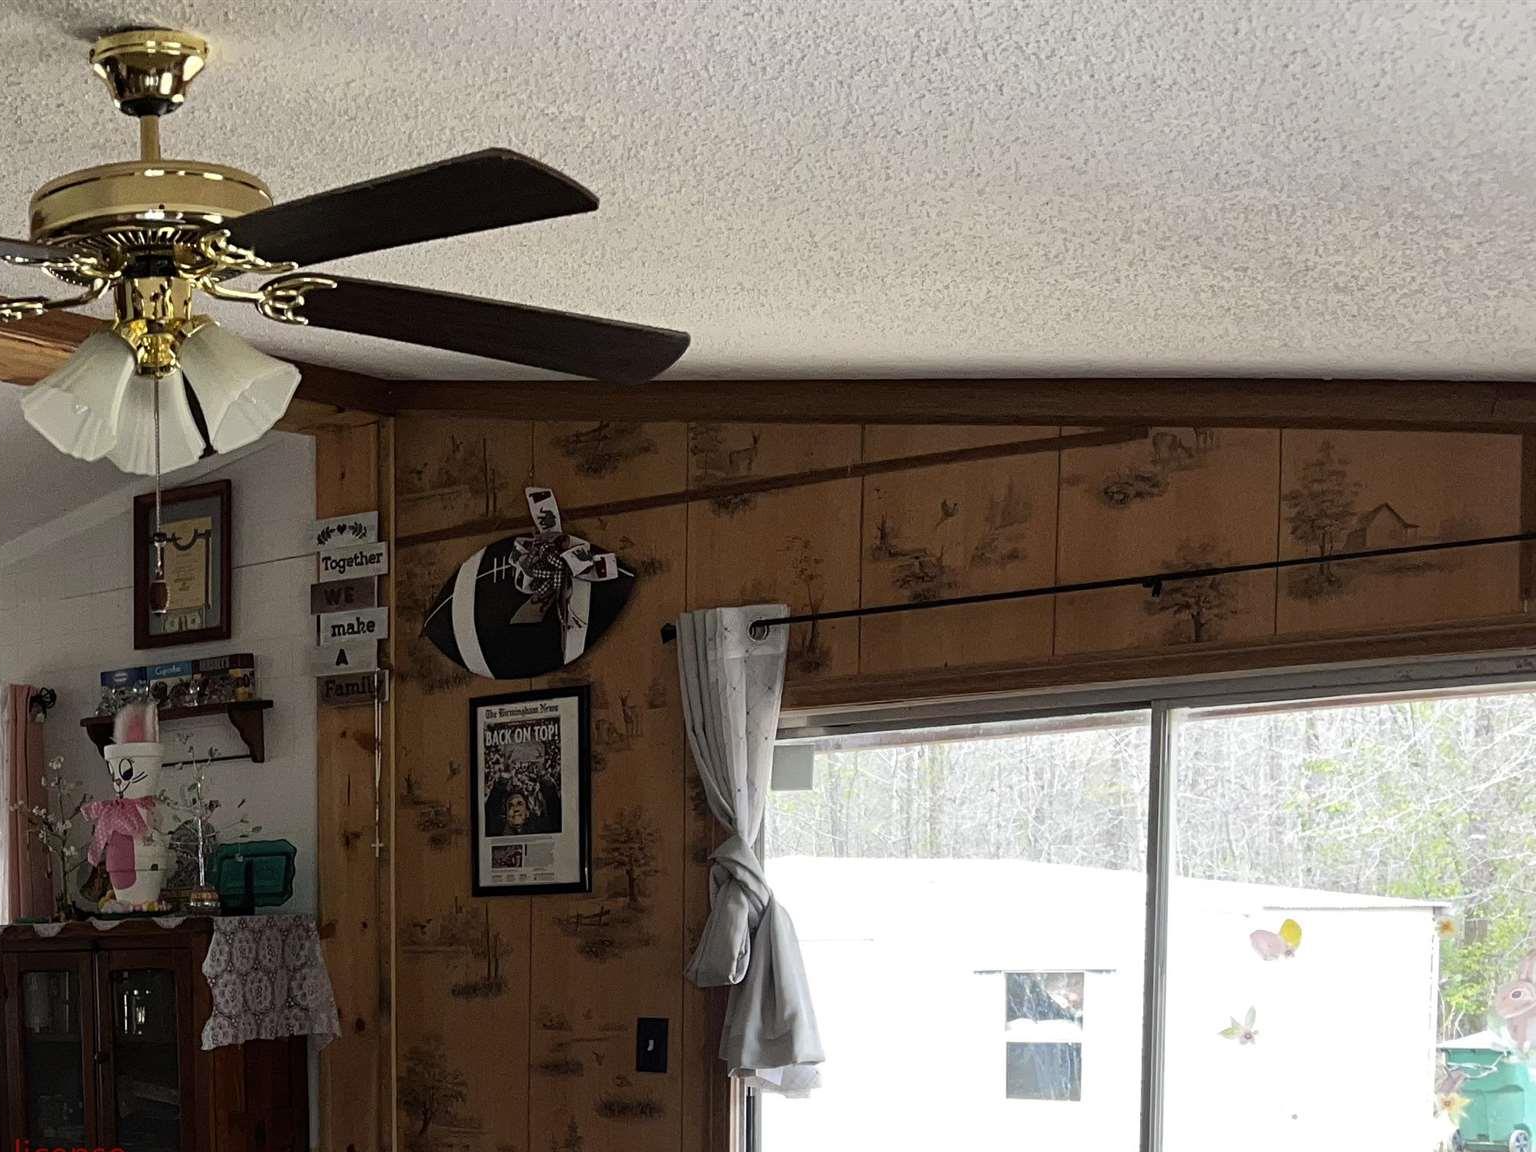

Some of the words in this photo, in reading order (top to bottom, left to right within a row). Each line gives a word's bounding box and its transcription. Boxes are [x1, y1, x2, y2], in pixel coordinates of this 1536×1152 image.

[322, 550, 384, 574] Together
[324, 586, 355, 606] WE
[331, 616, 376, 637] make
[335, 648, 349, 666] A
[485, 708, 498, 719] The
[539, 702, 559, 713] News
[485, 729, 512, 747] BACK
[515, 726, 531, 743] ON
[534, 724, 559, 742] TOP!
